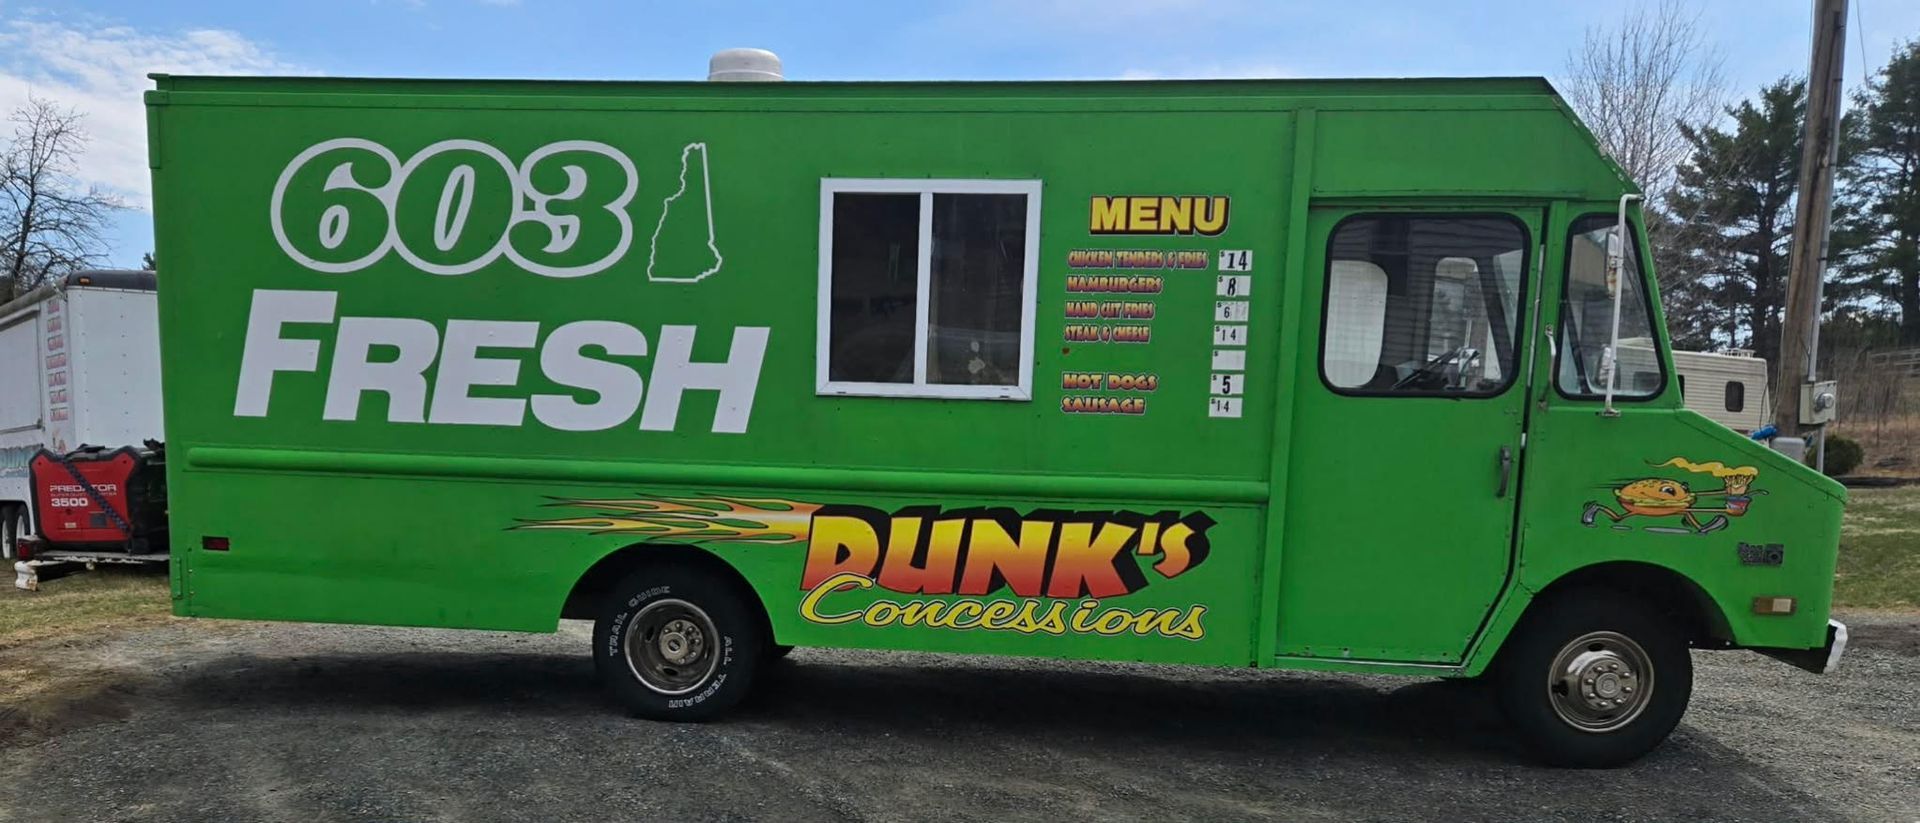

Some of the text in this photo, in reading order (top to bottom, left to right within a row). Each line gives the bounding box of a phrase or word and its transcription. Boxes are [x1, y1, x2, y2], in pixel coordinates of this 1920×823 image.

[270, 137, 639, 278] 603
[1089, 195, 1229, 236] MENU
[1068, 249, 1208, 271] CHICKEN TENDERS & FRIES
[1066, 275, 1163, 294] HAMBURGERS
[1065, 301, 1154, 320] HAND CUT FRIES
[1064, 324, 1151, 344] STEAK & CHEESE
[232, 288, 771, 434] FRESH
[1062, 372, 1158, 391] HOT DOGS
[1061, 396, 1146, 414] SAUSAGE
[49, 484, 117, 492] PREDTOR
[51, 497, 88, 507] 3500
[799, 573, 1209, 641] Concessions
[609, 585, 671, 657] TRAIL GUIDE
[668, 635, 733, 709] ALL TERRAIN
